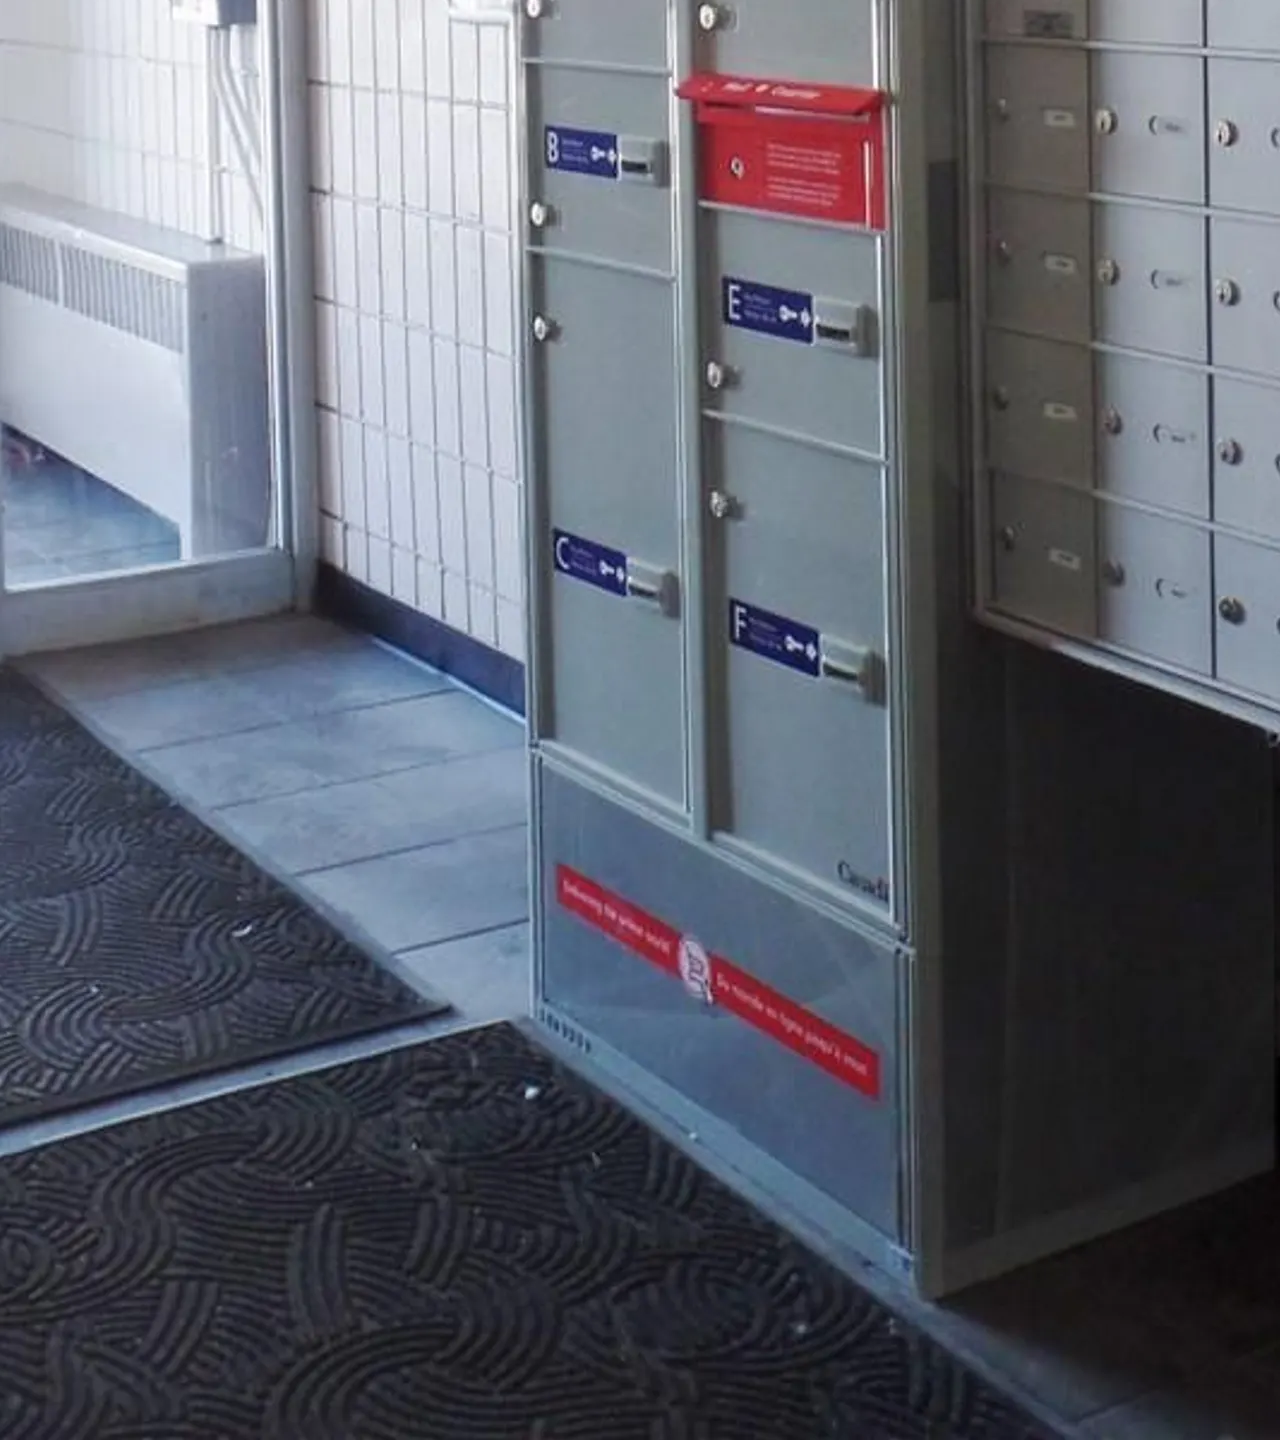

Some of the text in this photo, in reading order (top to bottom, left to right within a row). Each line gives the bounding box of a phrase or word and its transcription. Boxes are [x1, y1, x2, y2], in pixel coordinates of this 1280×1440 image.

[728, 283, 742, 321] E
[556, 536, 570, 570] C
[734, 604, 748, 640] F
